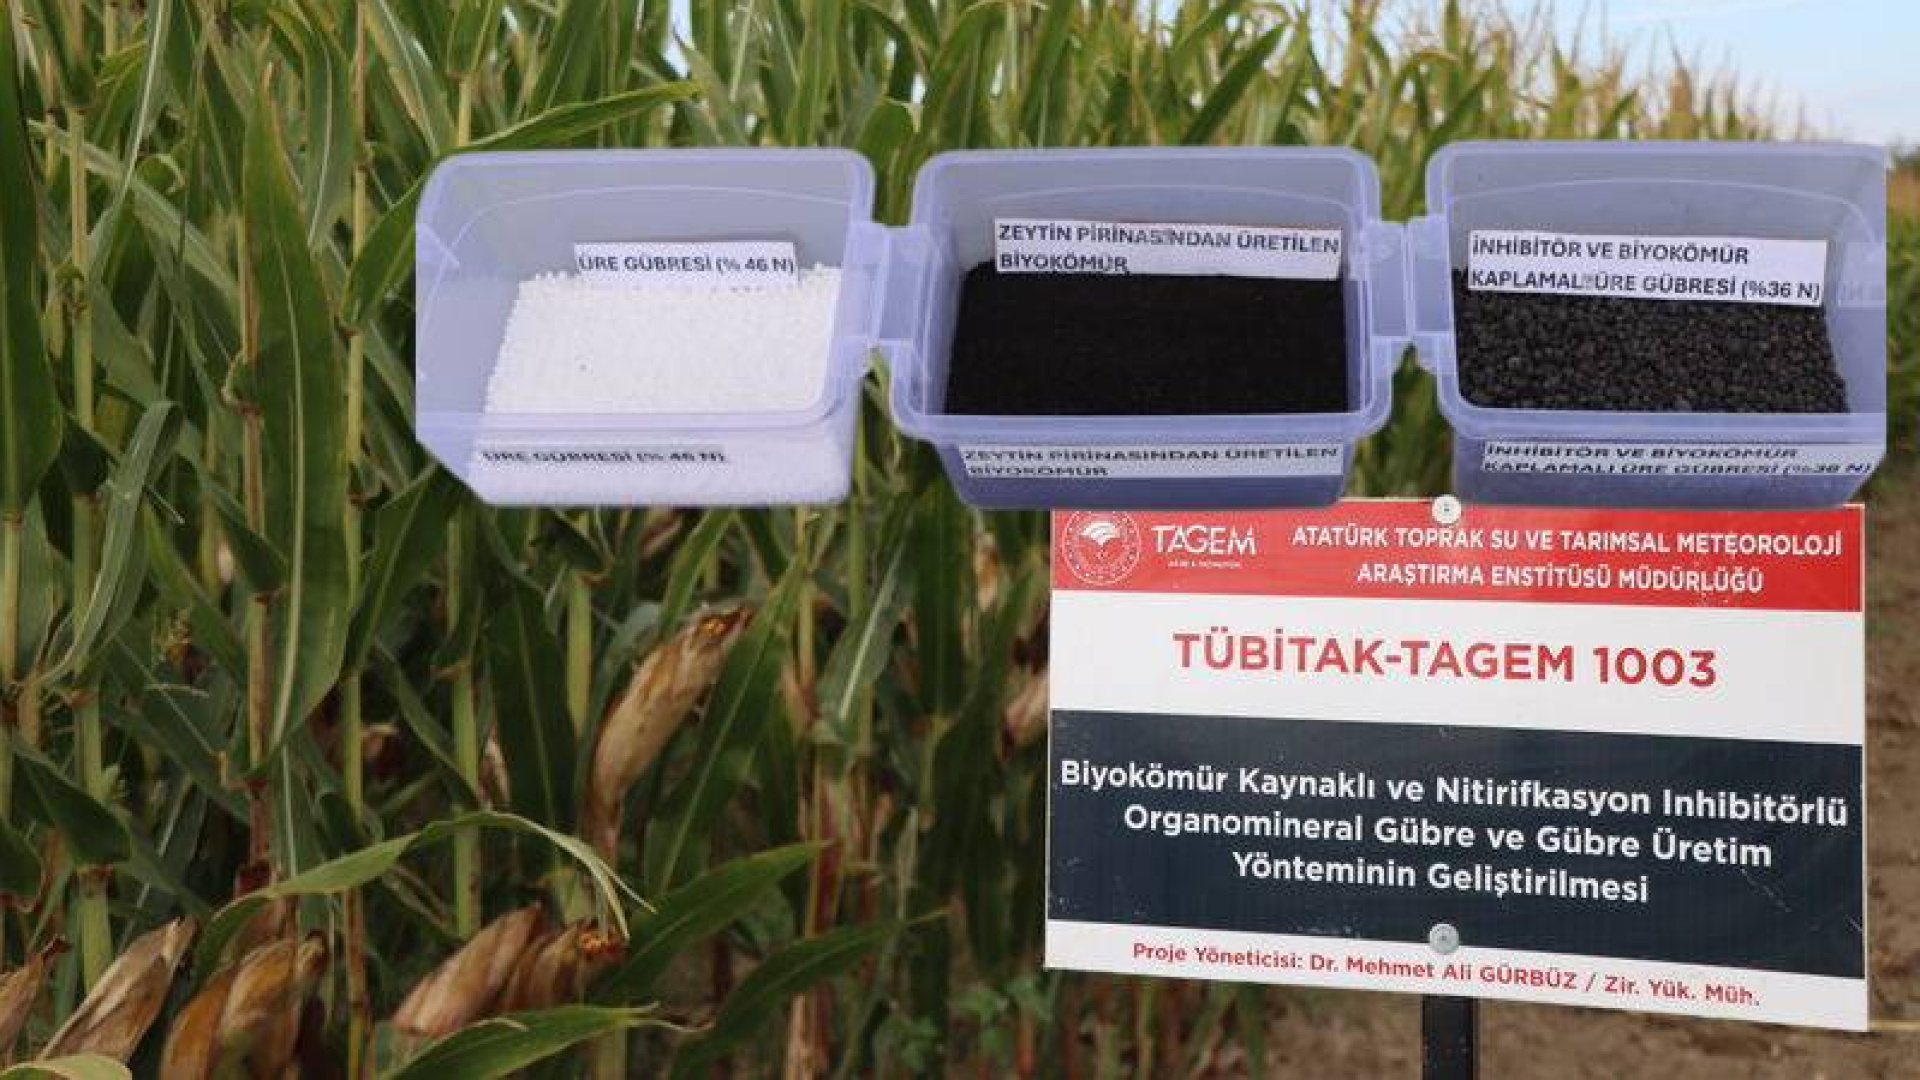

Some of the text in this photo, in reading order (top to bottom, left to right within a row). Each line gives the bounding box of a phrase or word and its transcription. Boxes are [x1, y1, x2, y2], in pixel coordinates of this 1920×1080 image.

[999, 223, 1071, 241] ZEYTİN
[1237, 231, 1339, 253] ÜRETİLEN
[1472, 236, 1748, 264] İNHİBİTÖR VE BİYOKÖMÜR
[579, 254, 619, 273] ÜRE
[624, 254, 711, 273] GÜBRESİ
[745, 256, 769, 272] 46
[773, 256, 796, 275] N)
[1000, 250, 1128, 273] BİYOKÖMÜR
[1595, 271, 1637, 291] ÜRE
[1643, 273, 1735, 295] GÜBRESİ
[1741, 279, 1792, 299] (%36
[1797, 280, 1820, 302] N)
[1615, 447, 1643, 458] VE
[1150, 524, 1256, 556] TAGEM
[1292, 523, 1843, 557] ATATÜRK TOPRAK SU VE TARIMSAL METEOROLOJİ
[1357, 561, 1764, 593] ARAŞTIRMA ENSTİTÜSÜ MÜDÜRLÜĞÜ
[1172, 626, 1718, 688] TÜBİTAK-TAGEM 1003
[1060, 760, 1849, 827] Biyokömür Kaynaklı ve Nitirifkasyon Inhibitörlü
[1124, 803, 1773, 868] Organomineral Gübre ve Gübre Üretim
[1232, 850, 1649, 903] Yönteminin Geliştirilmesi
[1133, 942, 1761, 1006] Proje Yöneticisi: Dr. Mehmet Ali GÜRBÜZ / Zir. Yük. Müh.
